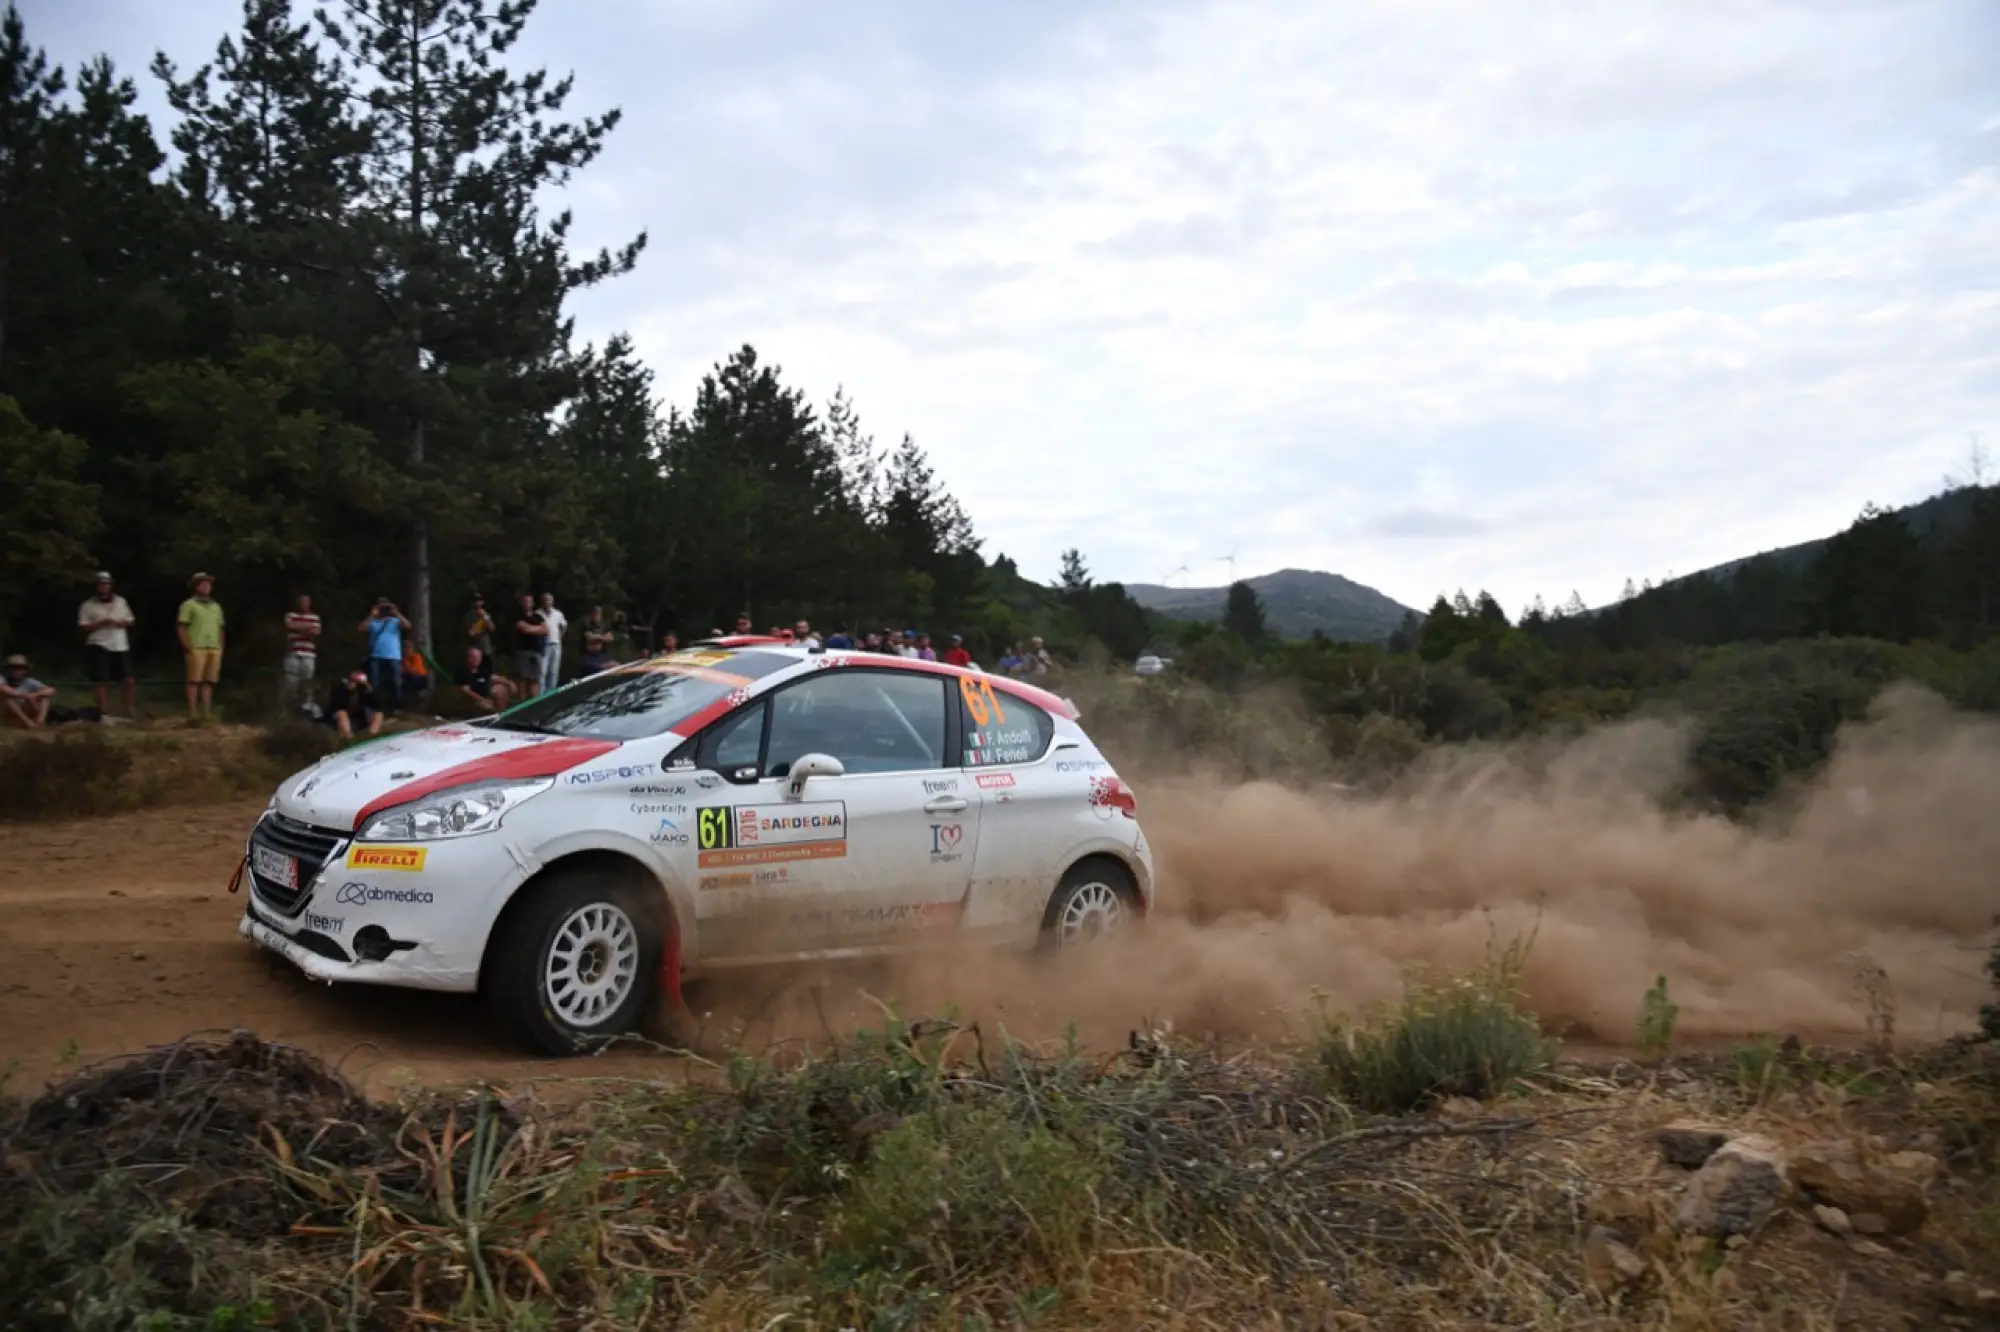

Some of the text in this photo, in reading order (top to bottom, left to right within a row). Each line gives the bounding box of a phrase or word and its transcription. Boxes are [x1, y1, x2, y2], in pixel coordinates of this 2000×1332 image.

[960, 675, 1005, 726] 61
[701, 808, 727, 849] 61
[740, 810, 759, 841] 2016
[761, 815, 841, 831] SARDEGNA
[650, 833, 689, 844] MAKO
[353, 847, 419, 866] PIRELLI
[366, 886, 434, 904] abmedica
